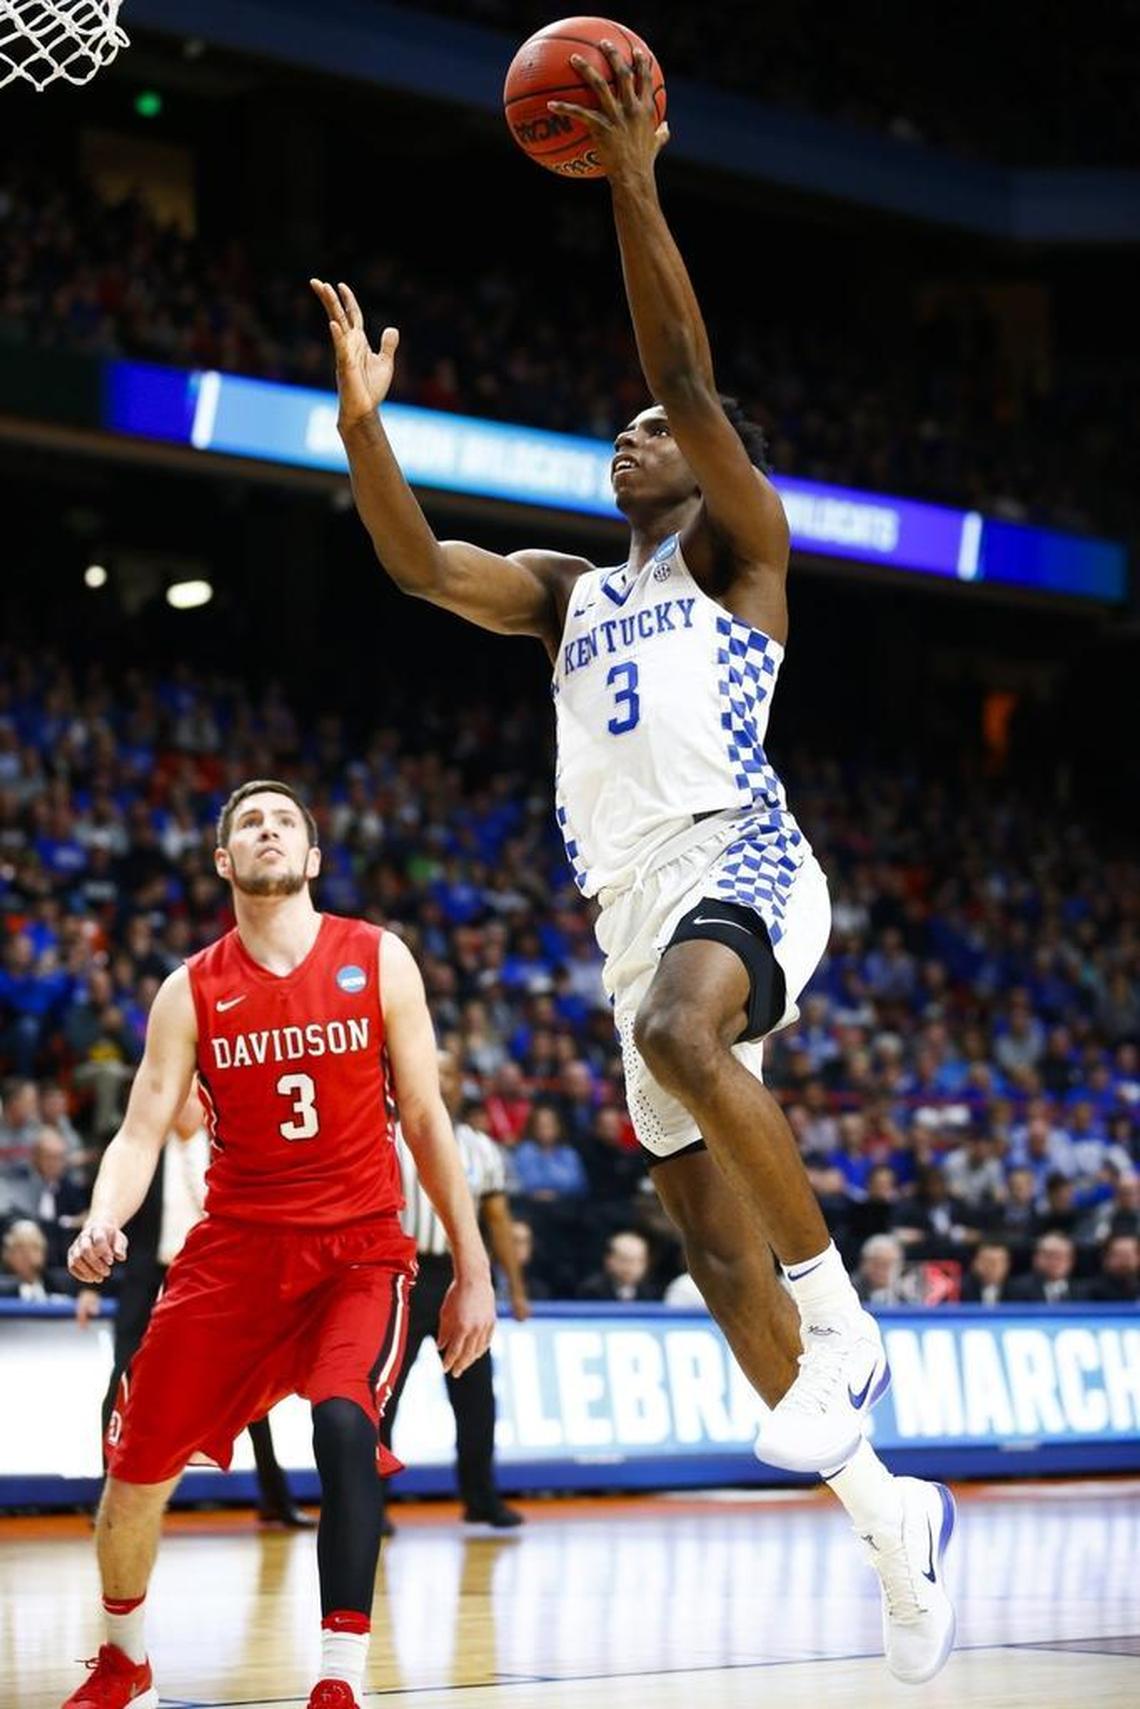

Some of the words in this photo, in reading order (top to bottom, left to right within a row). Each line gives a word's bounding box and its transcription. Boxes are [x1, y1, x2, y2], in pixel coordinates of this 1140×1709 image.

[564, 598, 695, 675] KENTUCKY
[607, 661, 640, 736] 3
[211, 1017, 369, 1069] DAVIDSON
[276, 1073, 320, 1141] 3
[885, 1327, 1140, 1439] MARCH
